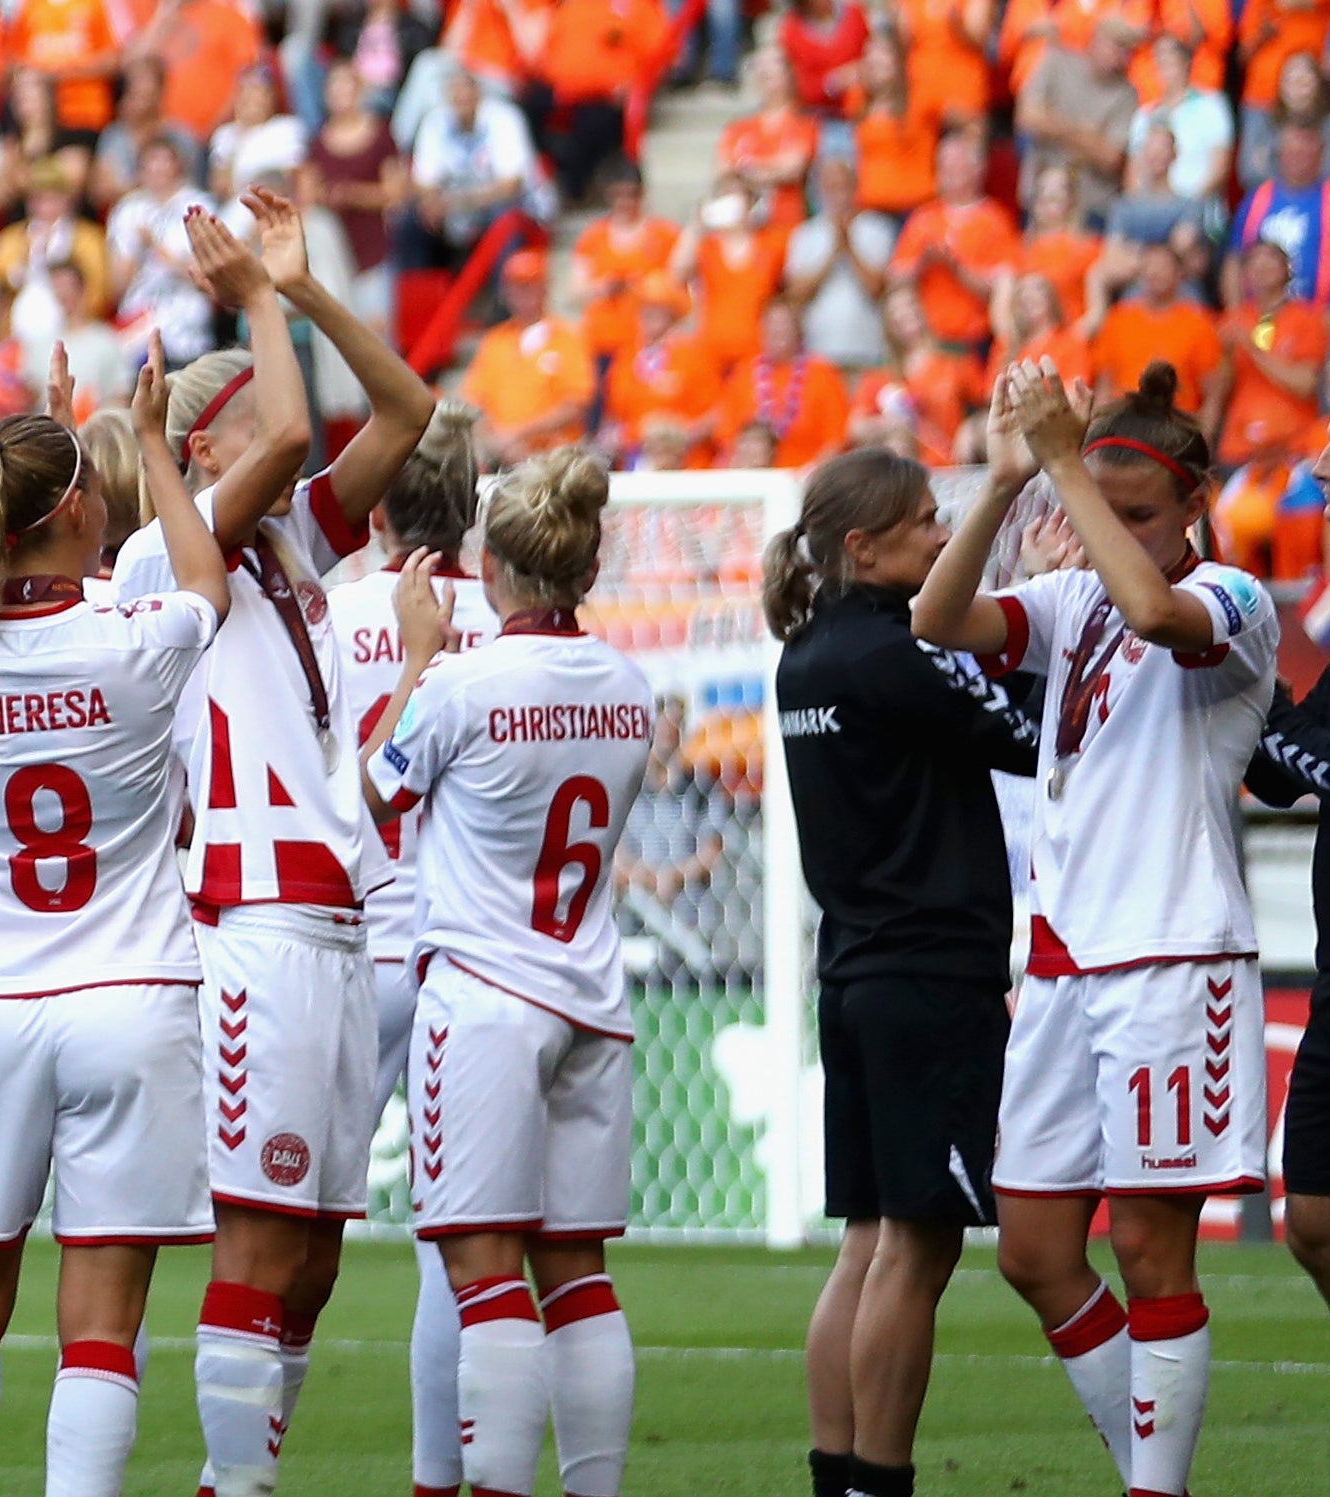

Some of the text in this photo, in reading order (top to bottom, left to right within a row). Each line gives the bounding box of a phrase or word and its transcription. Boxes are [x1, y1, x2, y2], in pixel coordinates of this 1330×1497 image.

[489, 703, 649, 743] CHRISTIANSEN
[4, 762, 98, 913] 8
[531, 774, 609, 944] 6
[1128, 1066, 1191, 1146] 11
[1142, 1153, 1197, 1169] hummel
